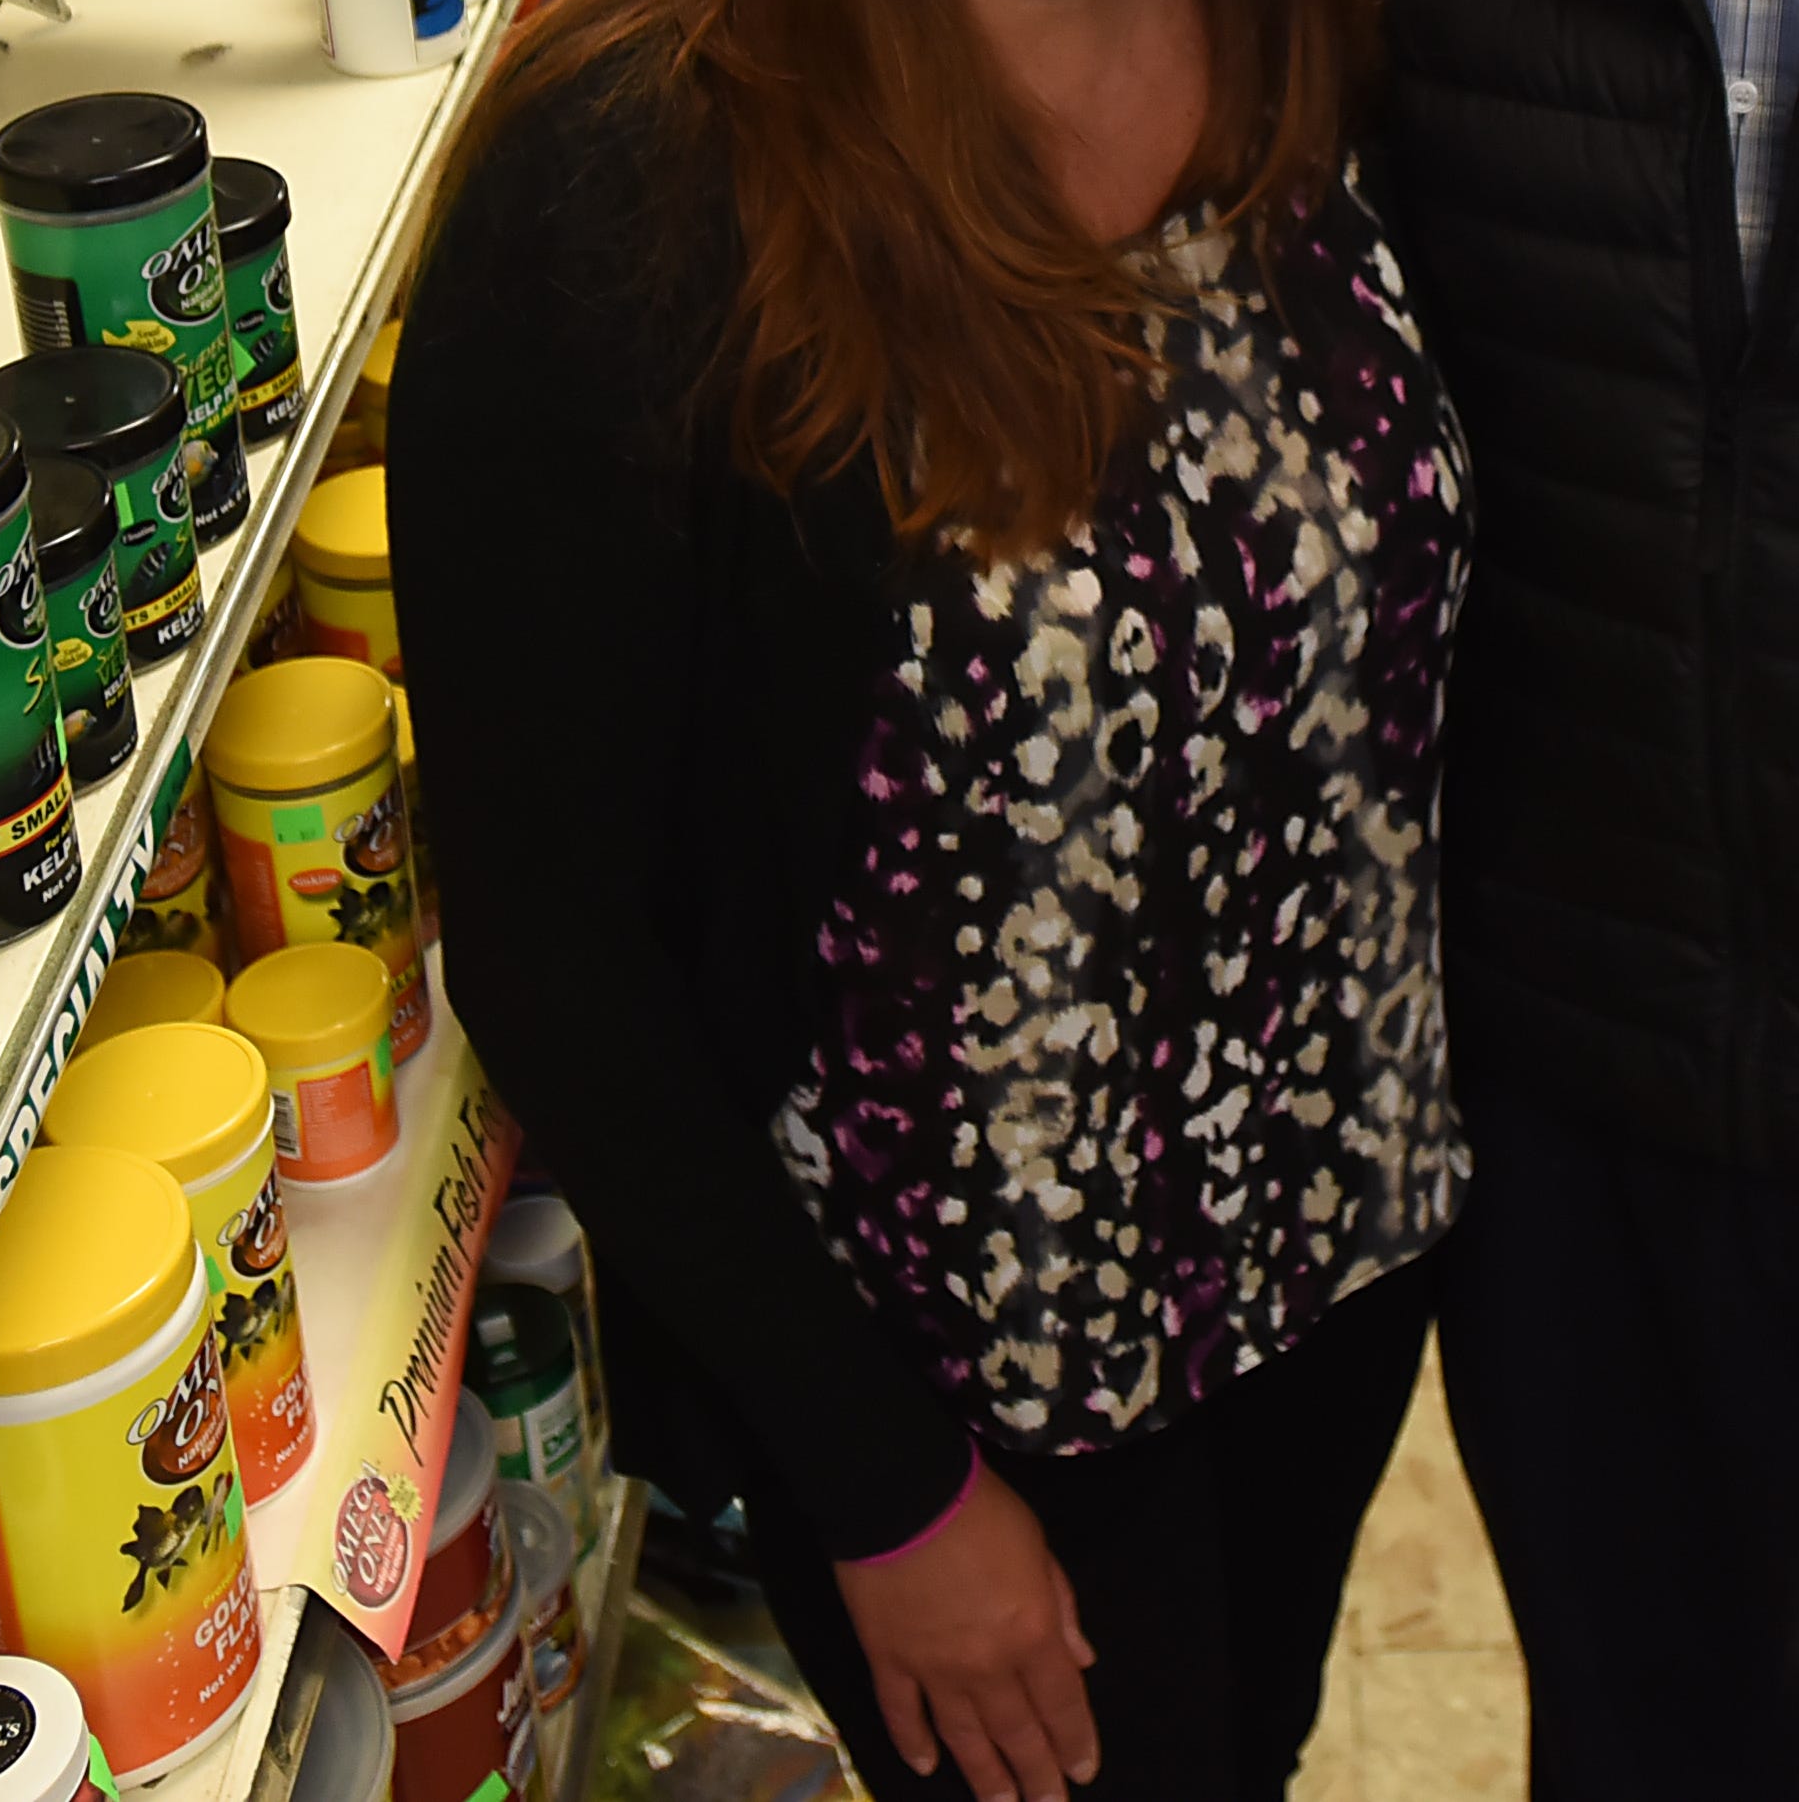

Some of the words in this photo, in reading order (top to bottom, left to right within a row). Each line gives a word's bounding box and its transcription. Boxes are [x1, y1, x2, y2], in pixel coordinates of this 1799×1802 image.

[11, 781, 69, 842] SMALL
[22, 840, 72, 893] KELP
[377, 1243, 466, 1469] Premium
[434, 1141, 487, 1266] Fish
